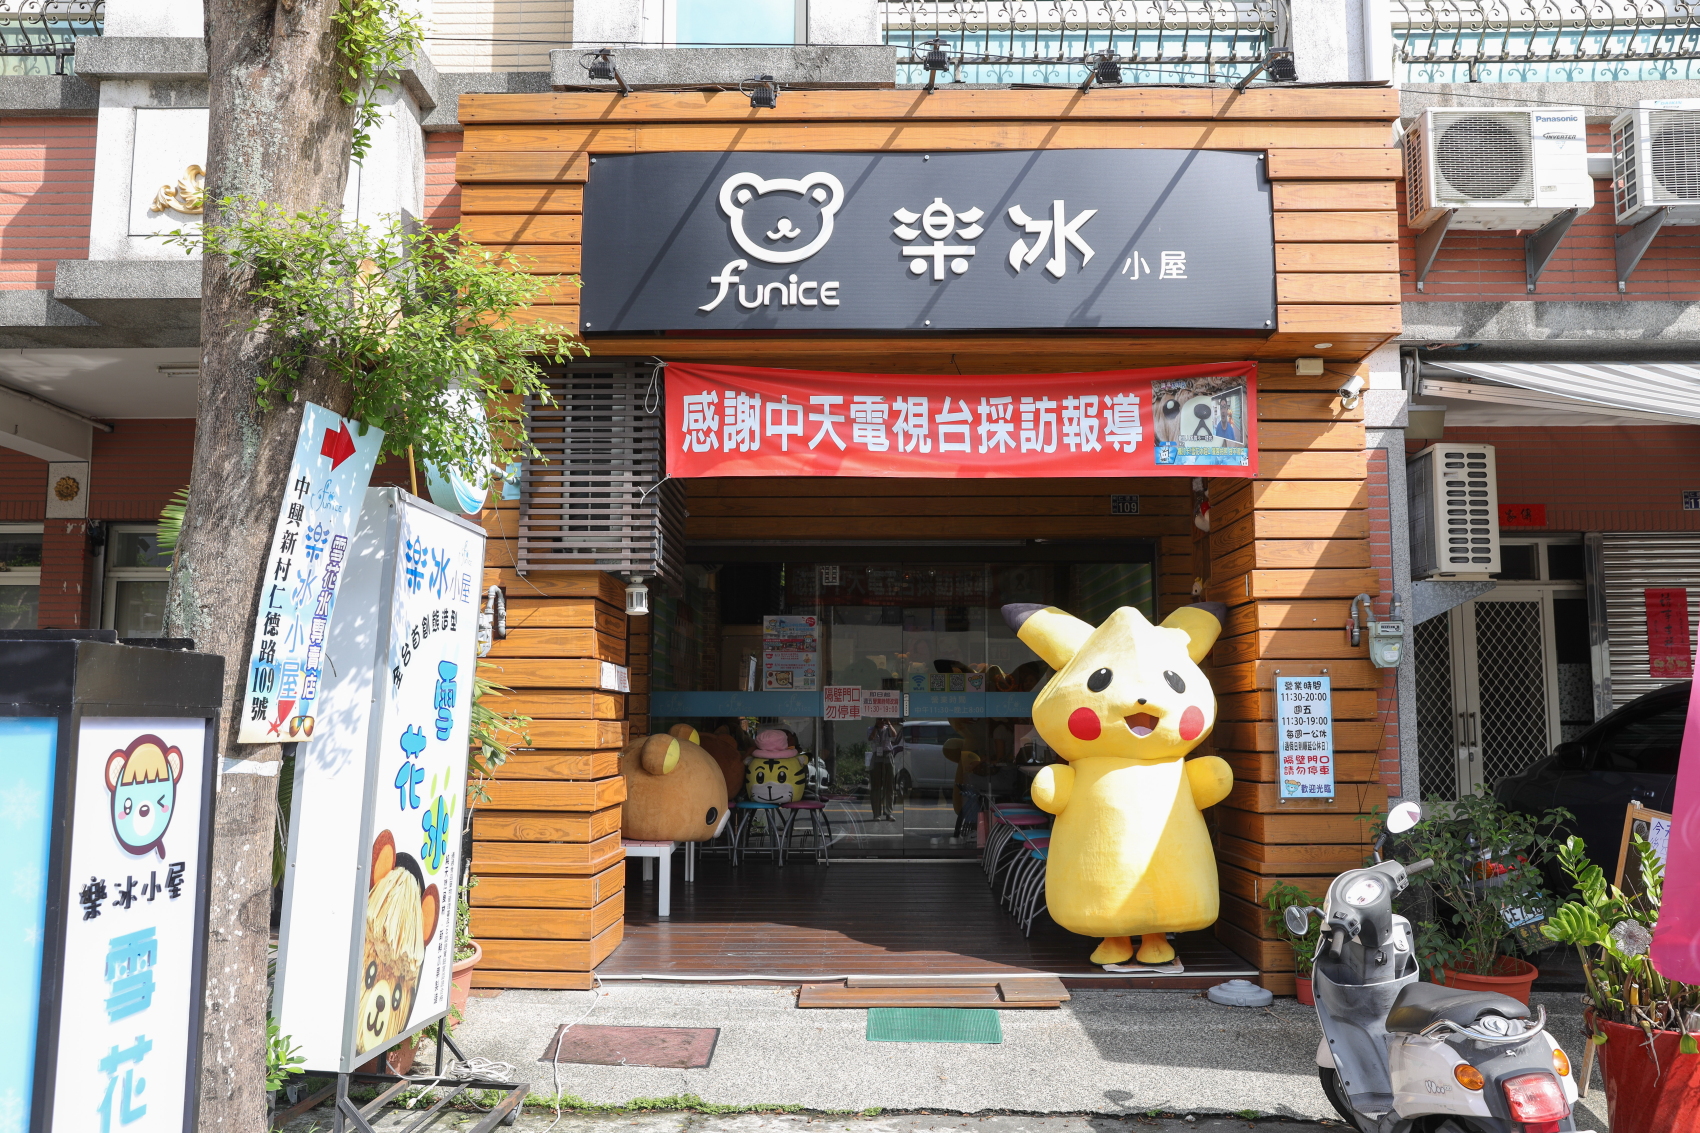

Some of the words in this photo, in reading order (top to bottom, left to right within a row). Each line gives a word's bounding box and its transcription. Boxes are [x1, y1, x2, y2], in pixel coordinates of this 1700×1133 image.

[1535, 114, 1578, 123] Panasonic
[1121, 249, 1189, 281] 小屋
[681, 388, 1144, 455] 感謝中天電視台採訪報導
[1118, 502, 1138, 513] 109
[250, 475, 311, 722] 中興新村仁德路109號
[300, 534, 349, 701] 雪花冰專賣店
[1284, 680, 1322, 691] 營業時間
[824, 687, 861, 703] 隔壁門口
[1280, 692, 1328, 702] 11:30-20:00
[825, 704, 861, 719] 勿停車
[1293, 704, 1312, 715] 週五
[1281, 716, 1328, 726] 11:30-19:00
[1286, 729, 1327, 739] 每週一公休
[394, 659, 459, 871] 雪花冰
[1283, 755, 1330, 765] 隔壁門口
[1284, 765, 1330, 776] 請勿停車
[1301, 784, 1332, 794] 歡迎光臨
[79, 861, 186, 921] 樂冰小屋
[96, 926, 158, 1133] 雪花
